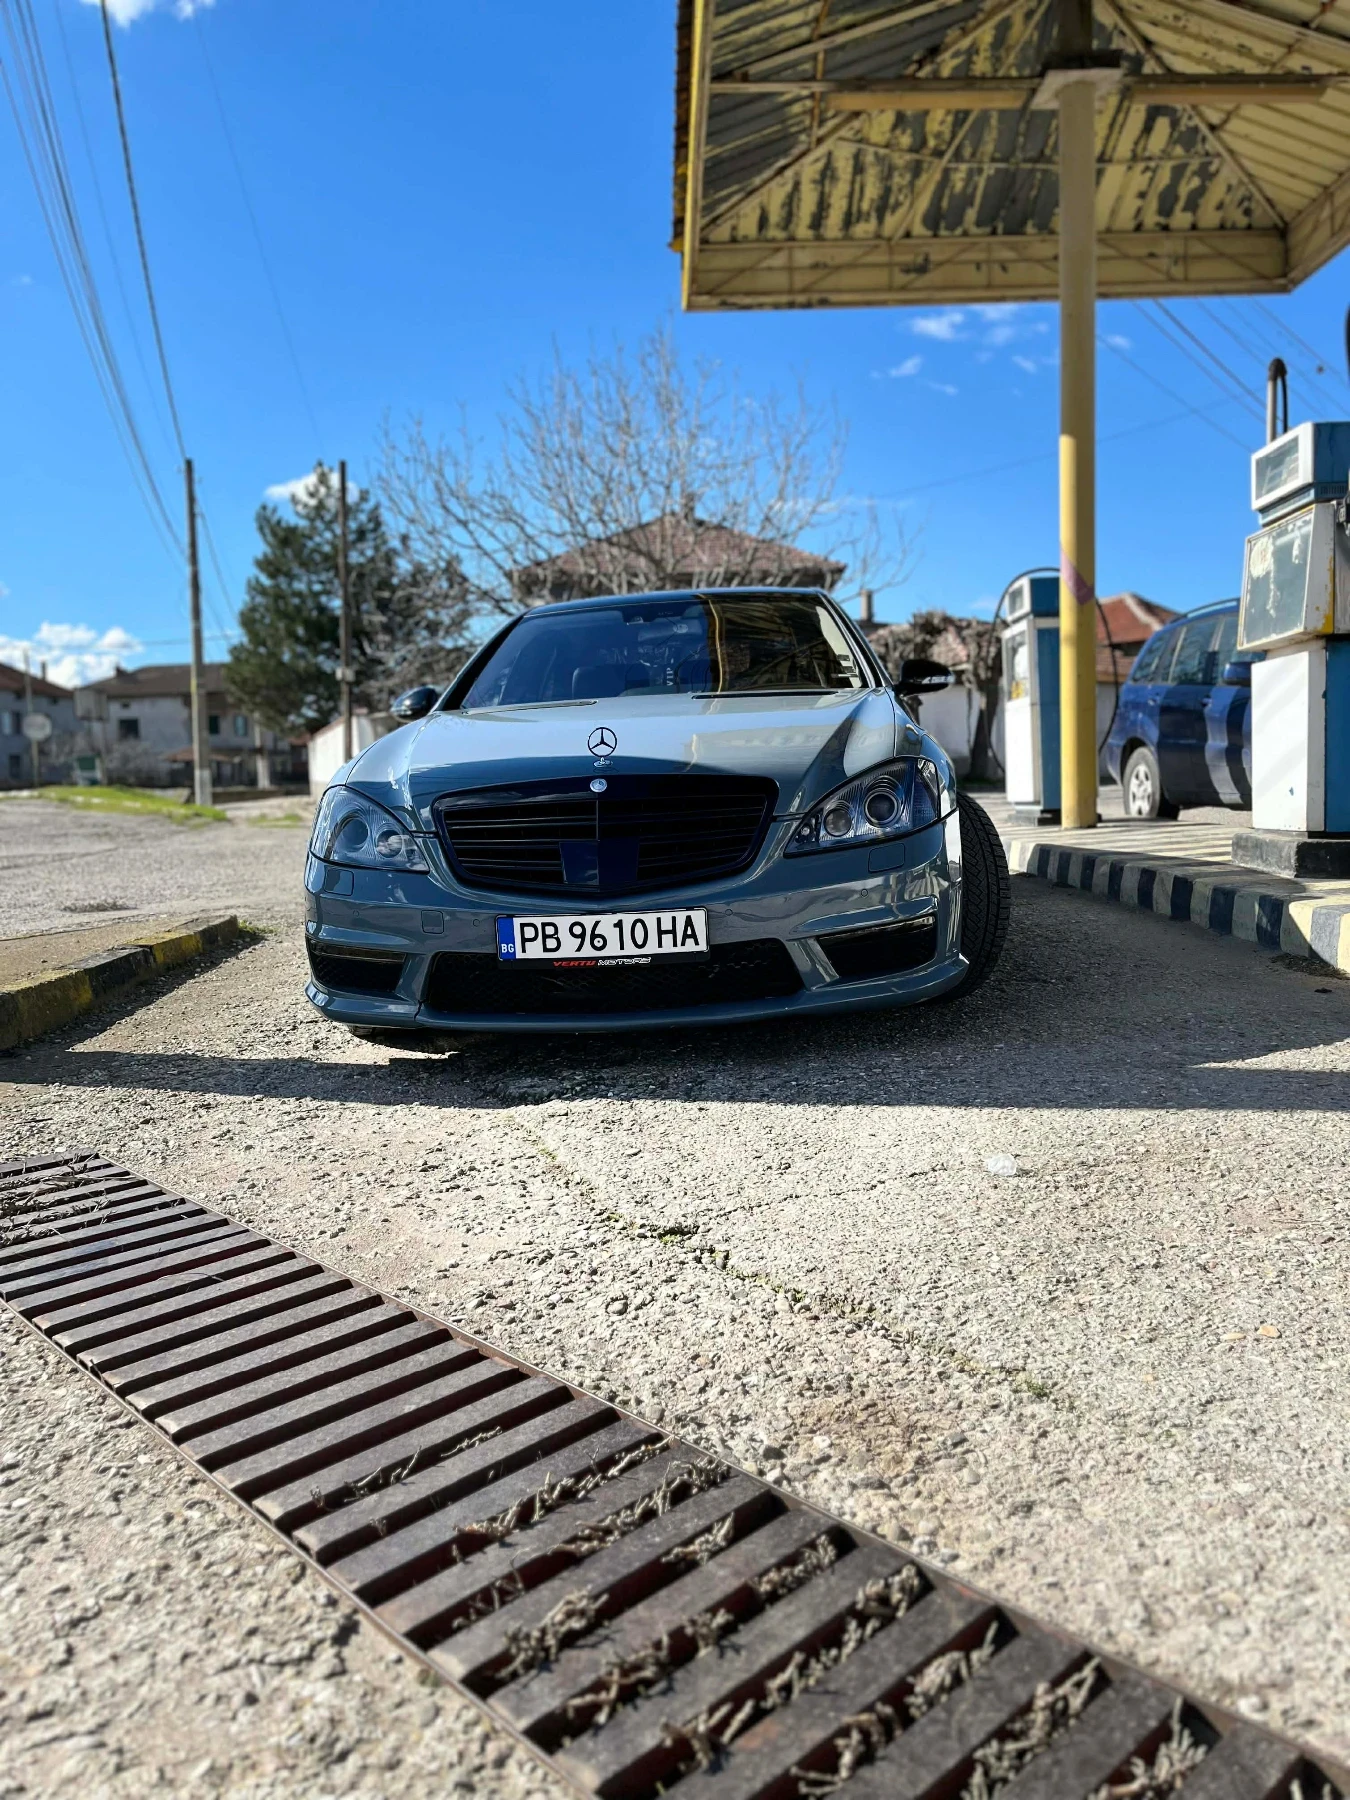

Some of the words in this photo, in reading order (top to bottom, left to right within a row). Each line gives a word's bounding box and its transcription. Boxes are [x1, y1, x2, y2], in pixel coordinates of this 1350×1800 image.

[519, 922, 562, 953] PB
[568, 918, 649, 952] 9610
[656, 915, 700, 948] HA
[501, 943, 515, 953] BG
[598, 957, 652, 966] MOTORS
